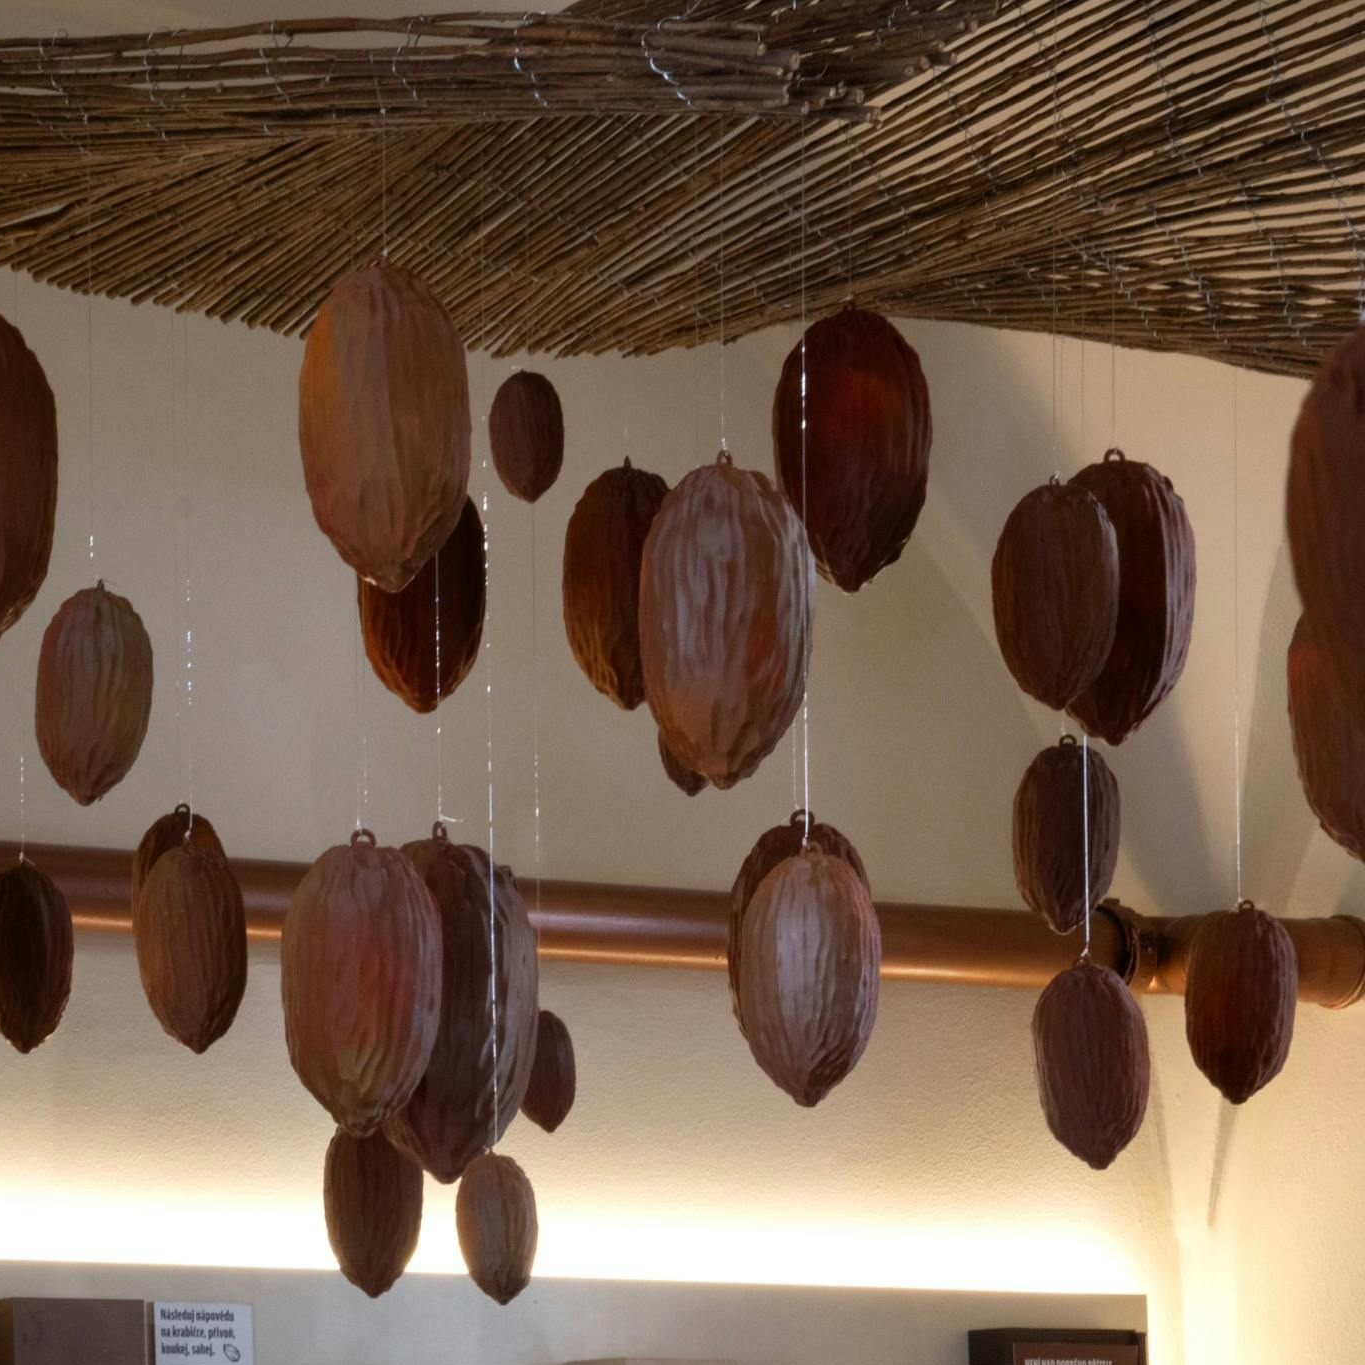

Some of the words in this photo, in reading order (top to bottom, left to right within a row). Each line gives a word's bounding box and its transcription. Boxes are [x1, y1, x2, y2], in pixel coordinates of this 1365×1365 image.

[160, 1308, 194, 1323] Následuj
[161, 1328, 170, 1337] na
[161, 1342, 190, 1357] koukej,
[192, 1343, 215, 1357] sahej.
